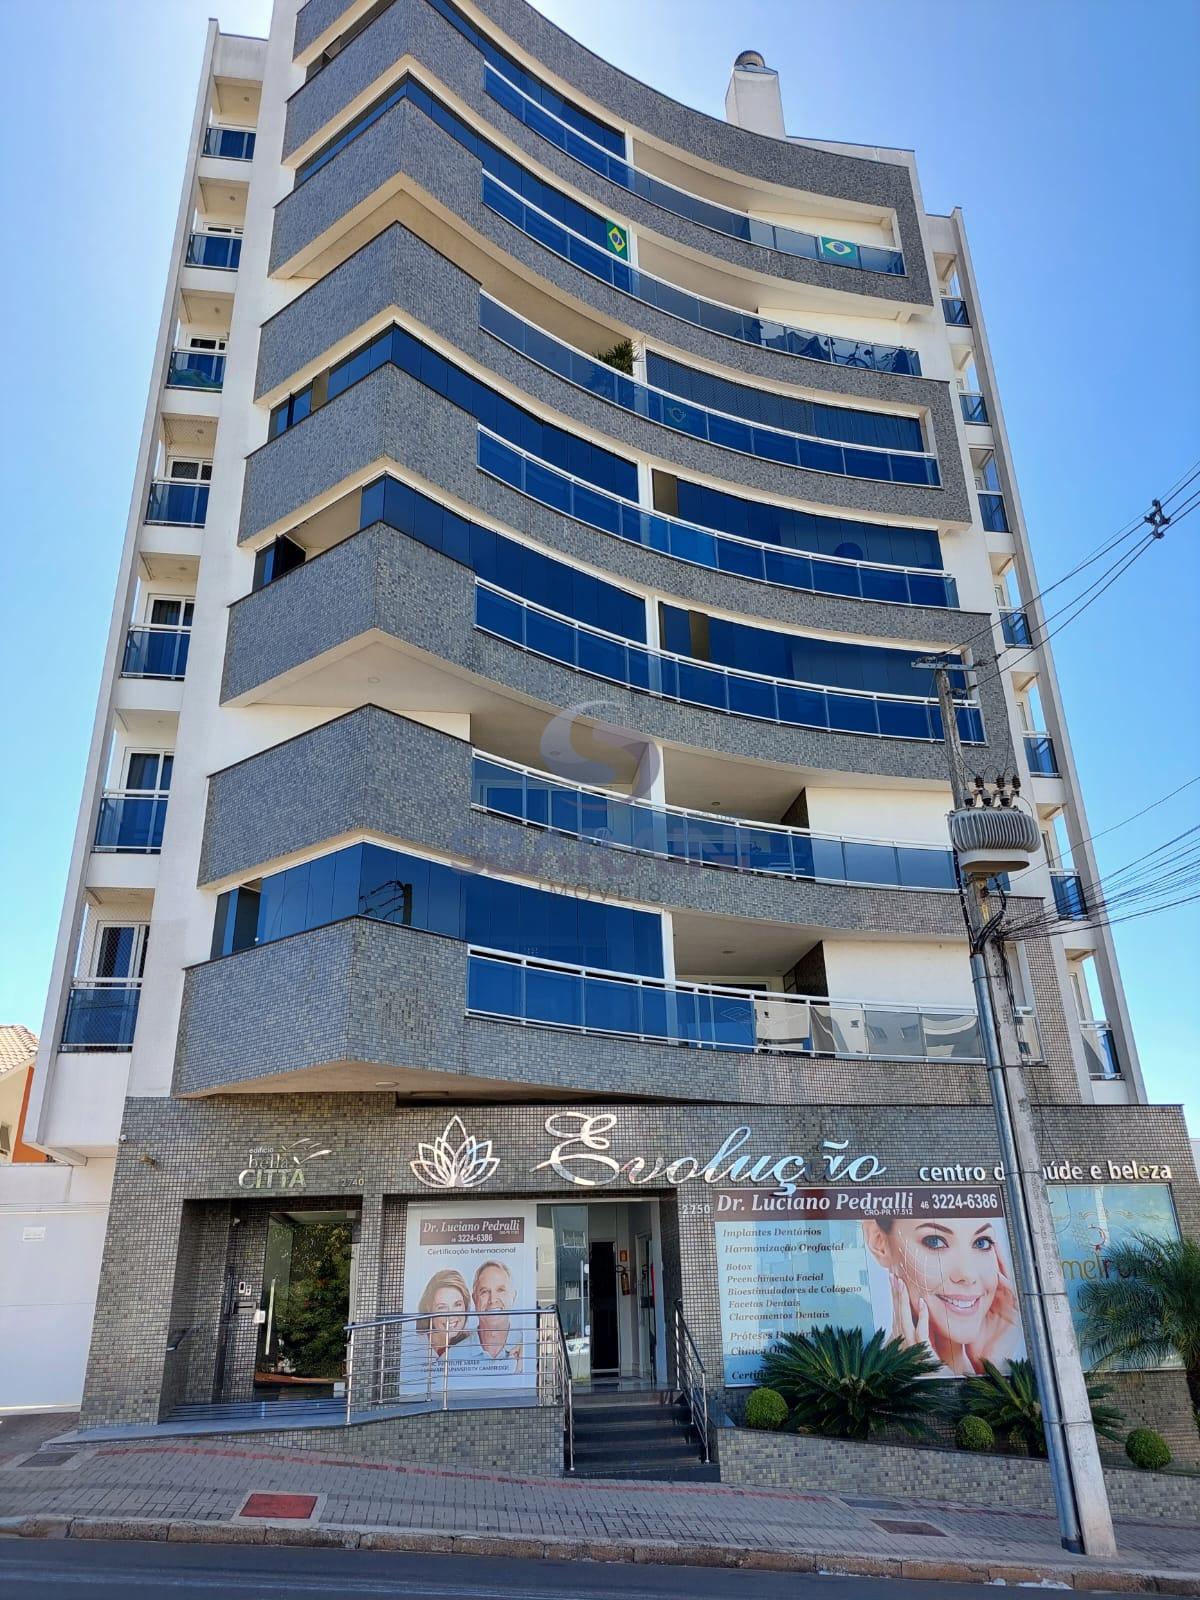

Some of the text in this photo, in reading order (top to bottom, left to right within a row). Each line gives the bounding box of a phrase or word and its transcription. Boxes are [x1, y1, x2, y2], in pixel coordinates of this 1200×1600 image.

[529, 1111, 886, 1196] Evolução
[919, 1165, 986, 1181] centro
[993, 1161, 1006, 1181] d
[1091, 1166, 1101, 1180] e
[1108, 1161, 1172, 1180] beleza
[717, 1192, 998, 1211] Dr. Luciano Pedralli 46 3224-6386
[681, 1204, 711, 1215] 2750
[423, 1219, 520, 1233] Dr. Luciano Pedralli
[457, 1233, 493, 1242] 3224-6386
[723, 1227, 822, 1238] Implantes Dentários
[725, 1243, 845, 1254] Harmonização Orofacial
[726, 1263, 753, 1271] Botox
[727, 1274, 824, 1283] Preenchimento Facial
[728, 1287, 806, 1296] Bioestimuladores
[808, 1286, 818, 1294] de
[728, 1299, 801, 1308] Facetas Dentais
[729, 1311, 830, 1322] Clareamentos Dentais
[731, 1331, 773, 1341] Próteses
